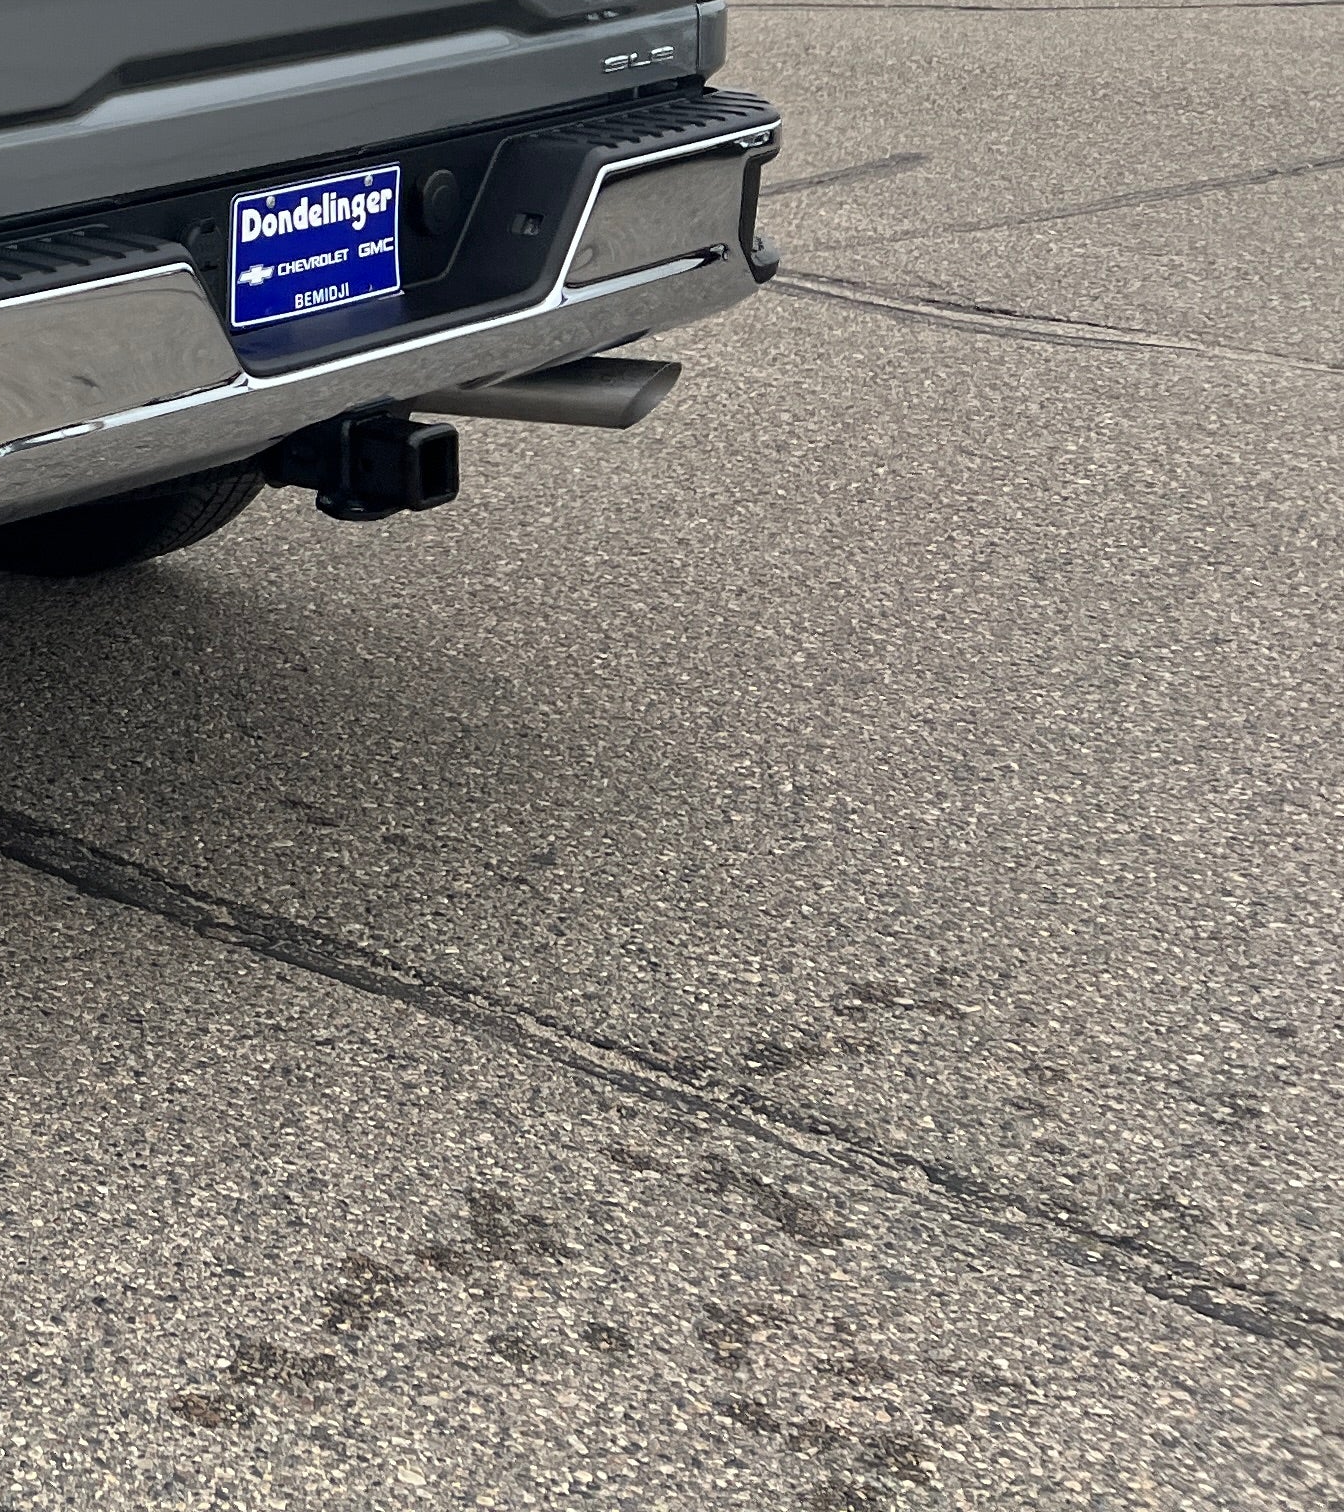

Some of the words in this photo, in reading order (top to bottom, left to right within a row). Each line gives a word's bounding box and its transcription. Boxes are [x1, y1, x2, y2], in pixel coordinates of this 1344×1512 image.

[602, 46, 674, 73] SLE
[241, 188, 393, 243] Dondelinger
[277, 248, 350, 276] CHEVROLET
[358, 237, 394, 258] GMC
[294, 282, 350, 309] BEMIDJI
